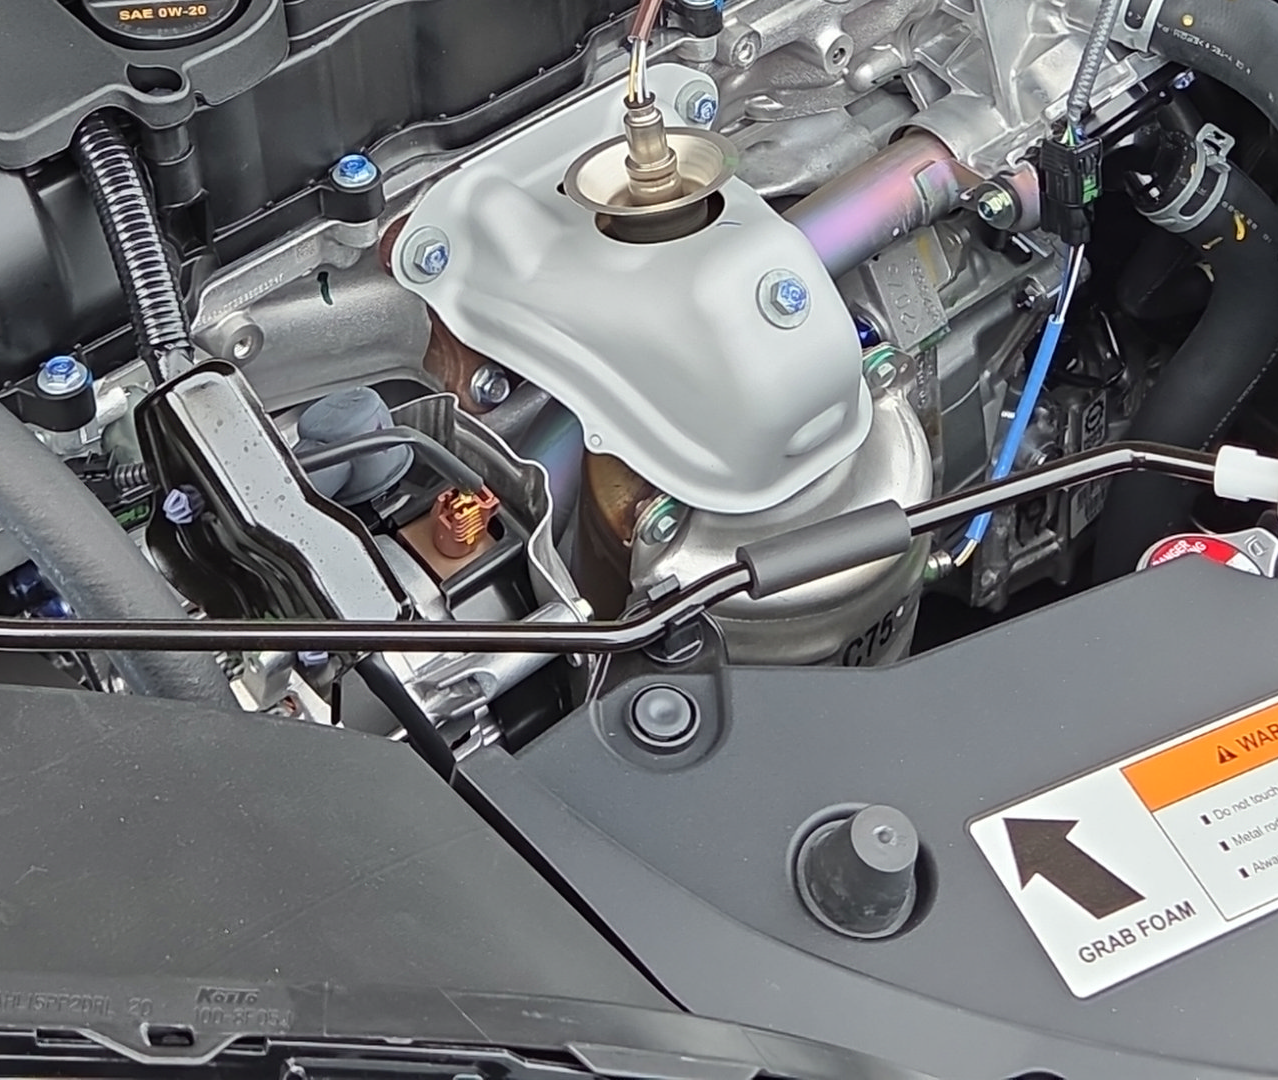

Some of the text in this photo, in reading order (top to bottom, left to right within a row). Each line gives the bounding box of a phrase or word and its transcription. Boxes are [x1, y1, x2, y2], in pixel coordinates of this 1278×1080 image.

[118, 4, 208, 21] SAE 0W-20
[1213, 808, 1231, 820] Do
[1232, 799, 1251, 812] not
[1231, 825, 1264, 846] Metal
[1078, 900, 1197, 963] GRAB FOAM
